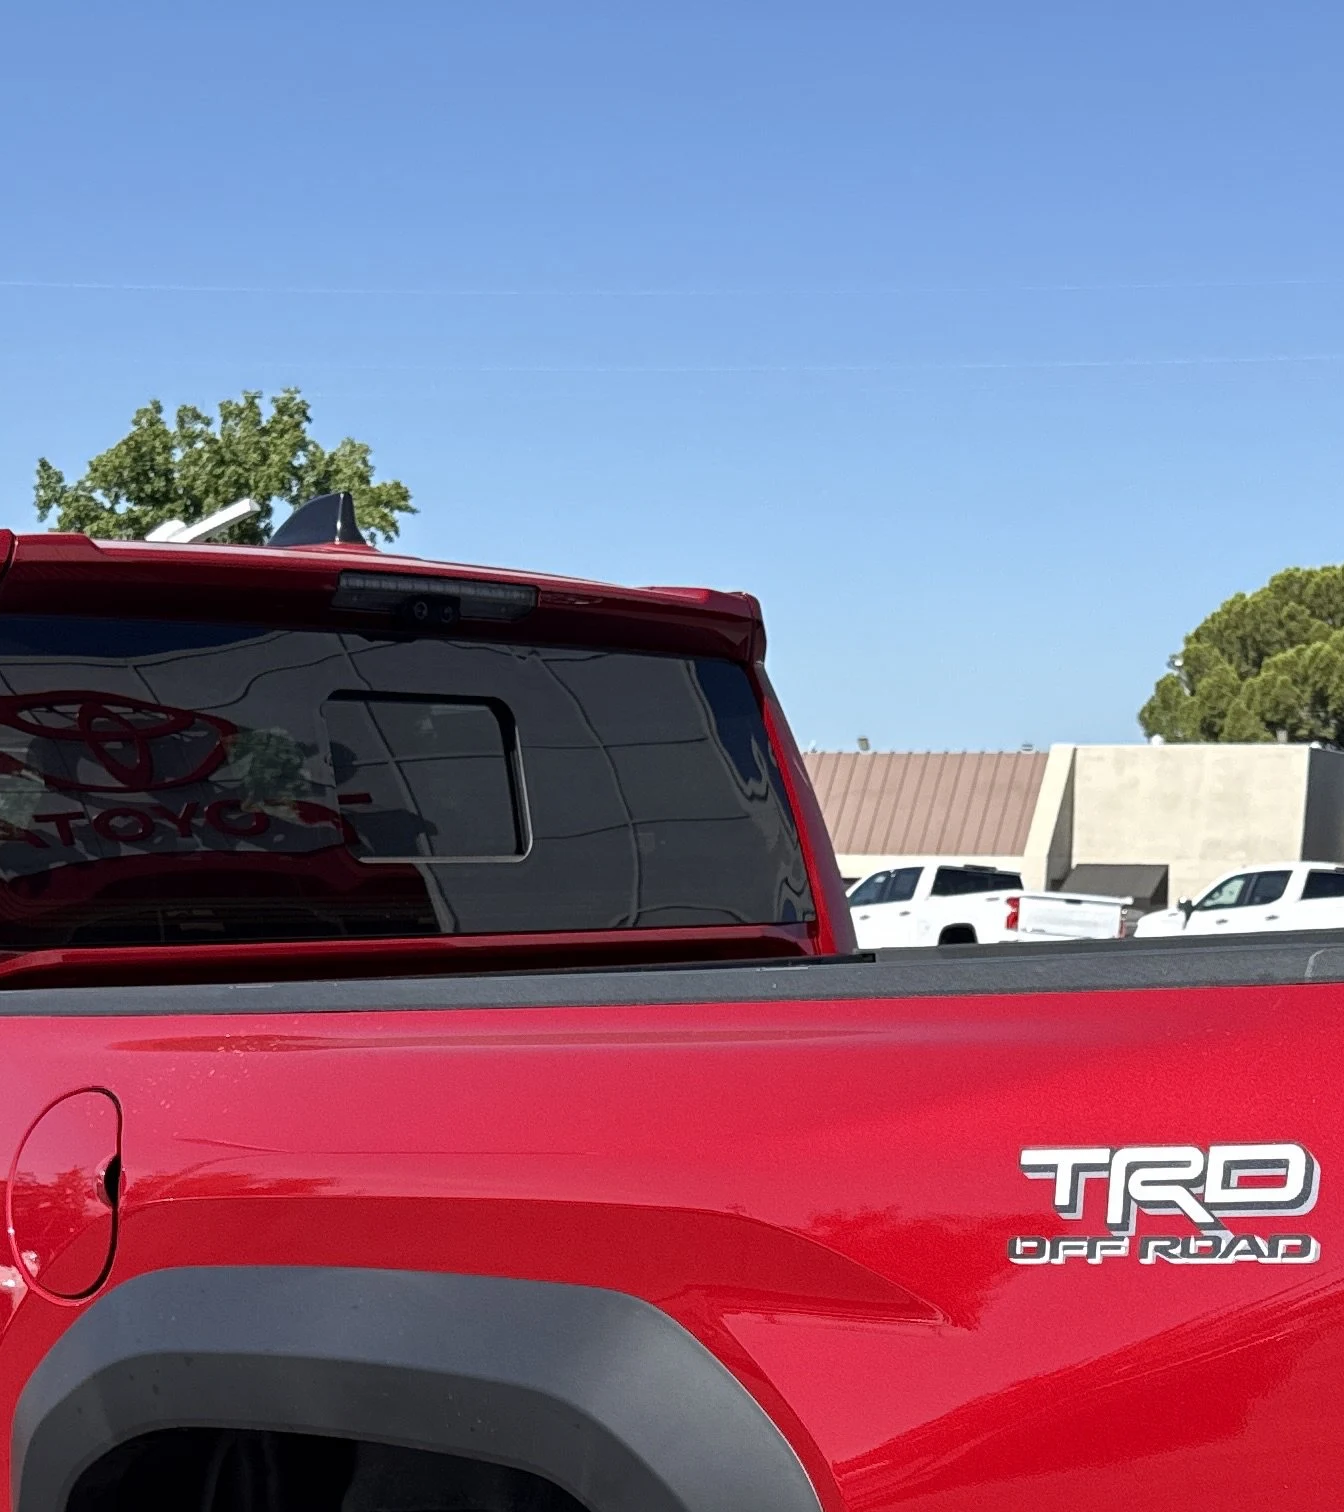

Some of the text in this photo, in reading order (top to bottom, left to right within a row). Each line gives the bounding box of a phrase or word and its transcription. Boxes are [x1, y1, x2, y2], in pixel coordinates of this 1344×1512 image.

[1019, 1141, 1321, 1236] TRD
[1007, 1234, 1321, 1264] OFF ROAD
